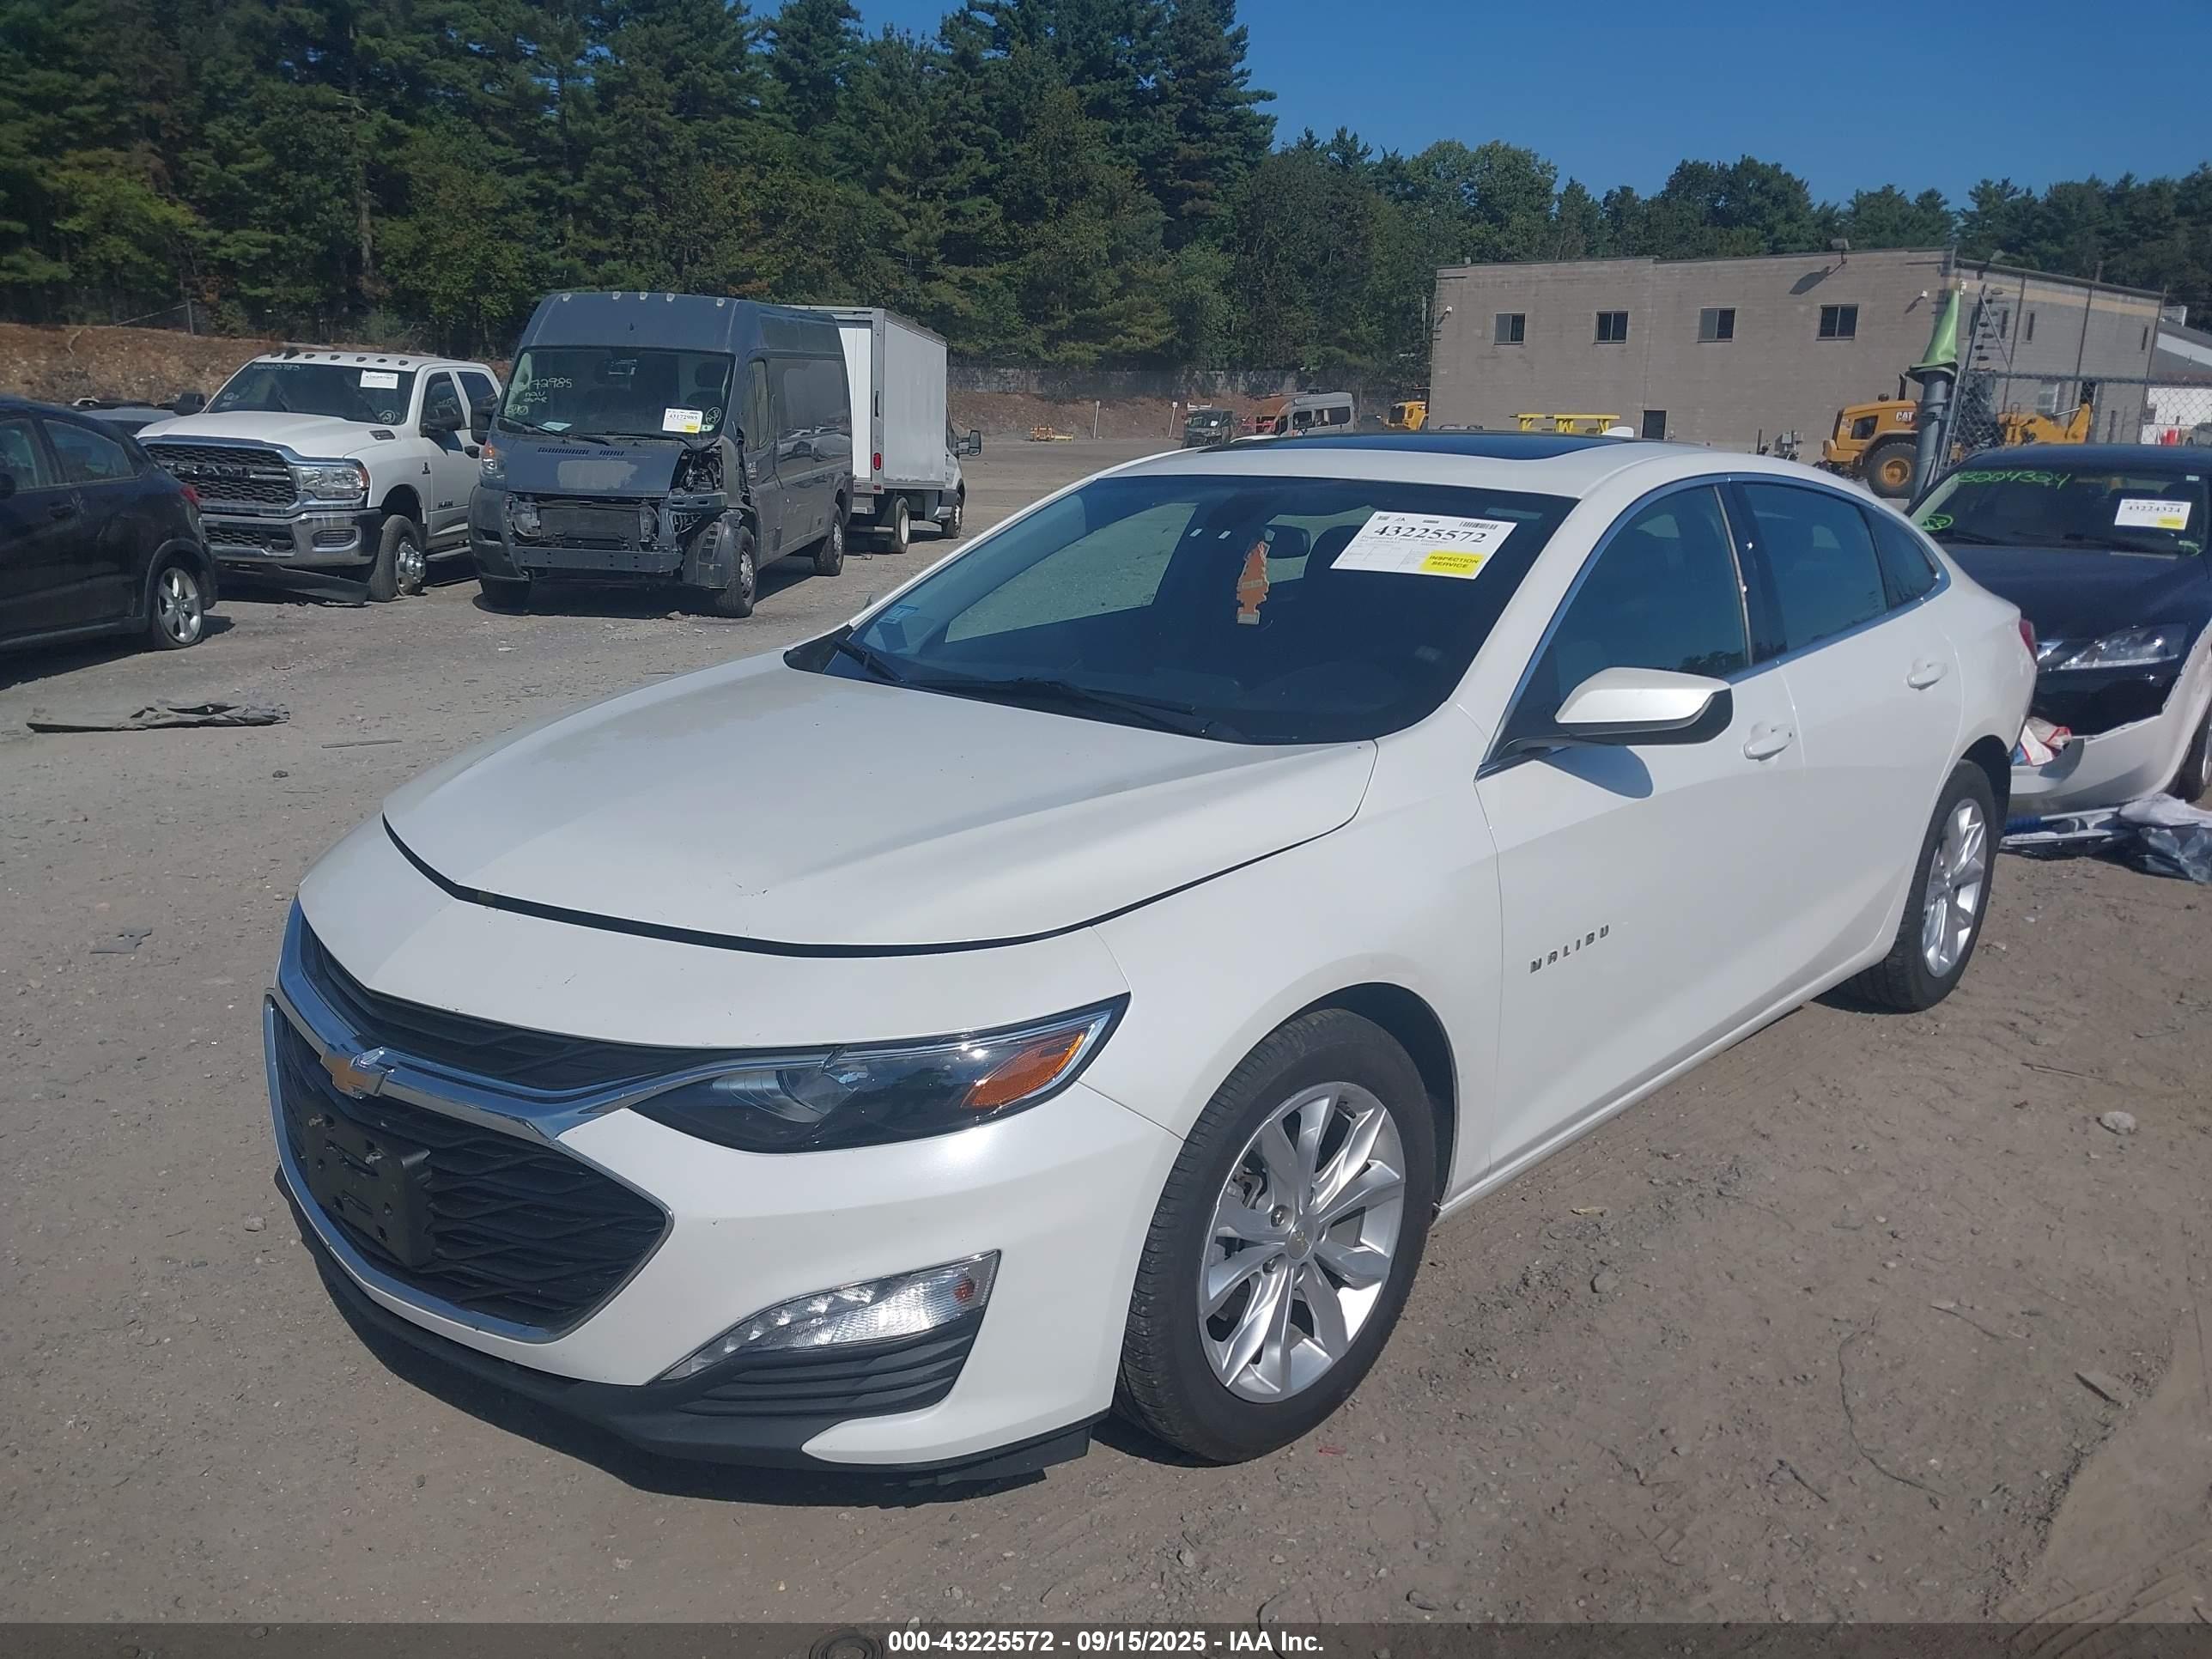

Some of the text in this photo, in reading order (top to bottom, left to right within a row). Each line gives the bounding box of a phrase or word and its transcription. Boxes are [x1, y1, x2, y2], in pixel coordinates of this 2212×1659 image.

[1895, 411, 1915, 422] CAT
[1374, 525, 1487, 544] 43225572
[1428, 555, 1480, 564] INSPECTION
[1530, 924, 1609, 974] MALIBU
